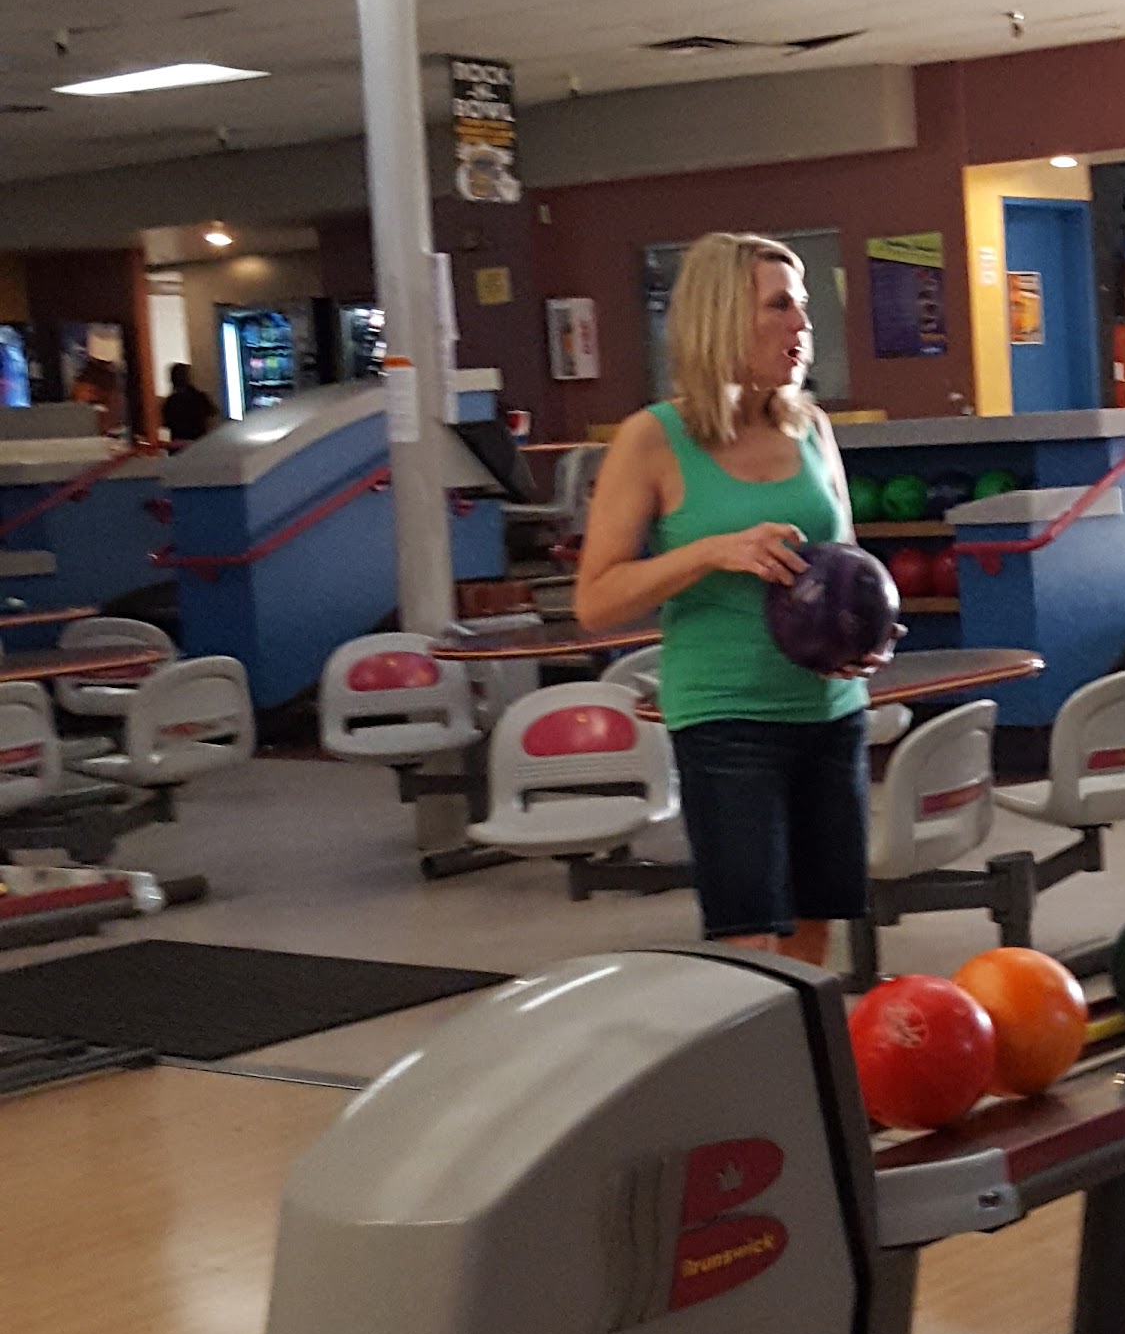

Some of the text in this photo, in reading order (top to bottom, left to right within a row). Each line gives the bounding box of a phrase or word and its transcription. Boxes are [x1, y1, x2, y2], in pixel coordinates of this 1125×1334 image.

[452, 61, 515, 85] ROCK
[453, 97, 516, 122] BOWL
[681, 1233, 774, 1278] Brunswick
